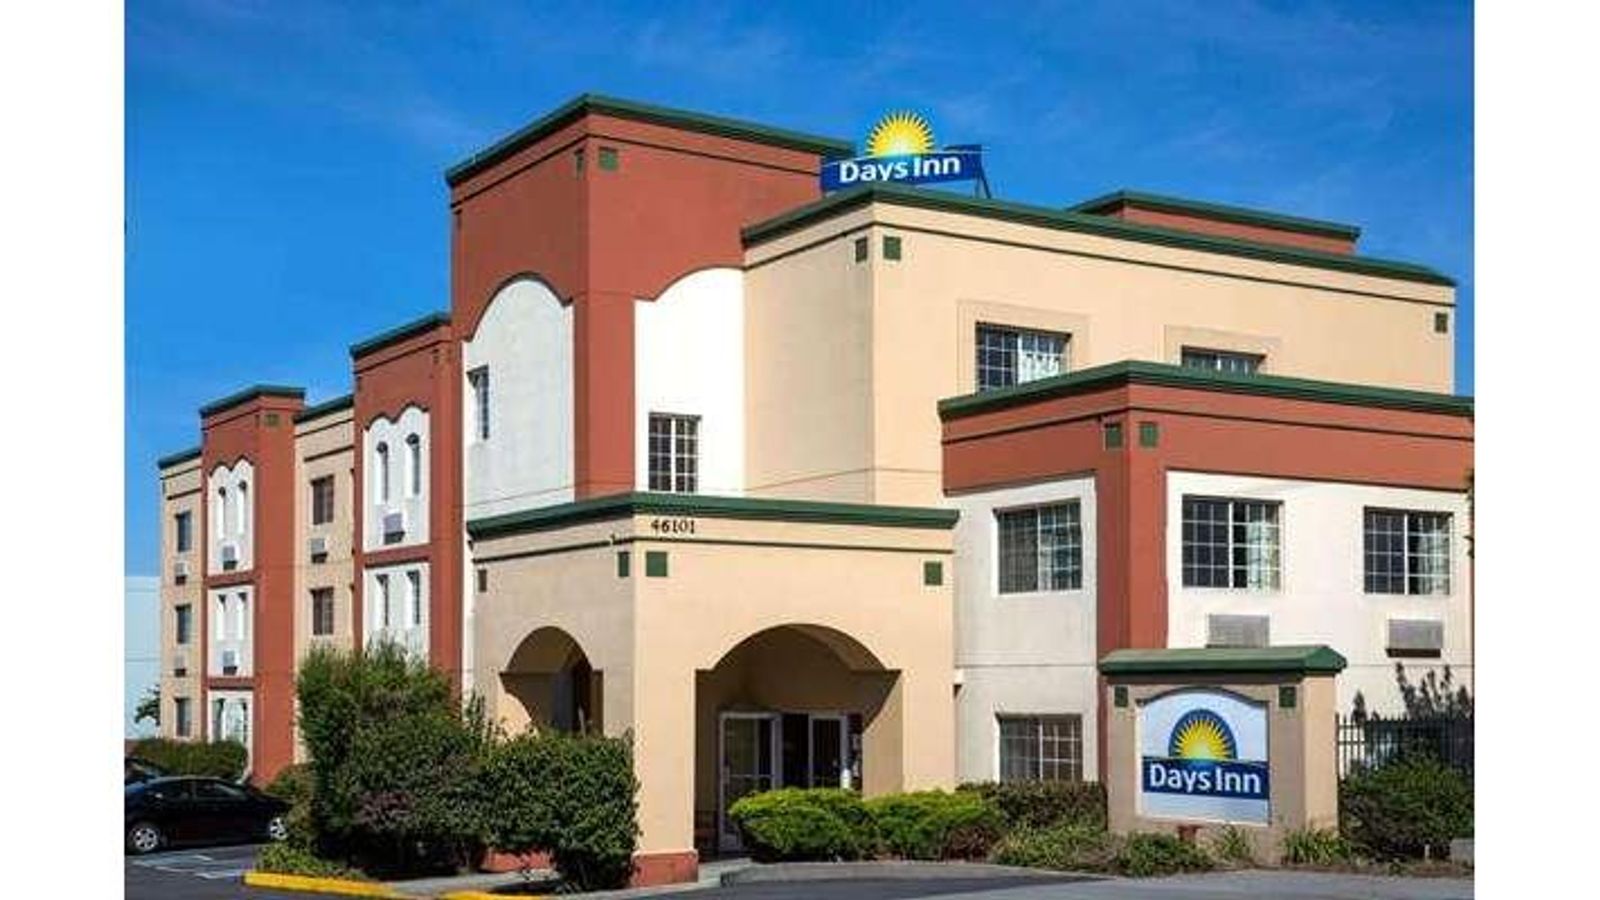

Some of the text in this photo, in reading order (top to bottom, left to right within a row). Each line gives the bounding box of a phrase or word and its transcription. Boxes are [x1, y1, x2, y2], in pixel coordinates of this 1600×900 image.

[839, 156, 960, 183] Days Inn
[650, 518, 695, 535] 46101
[1149, 763, 1261, 793] Days Inn
